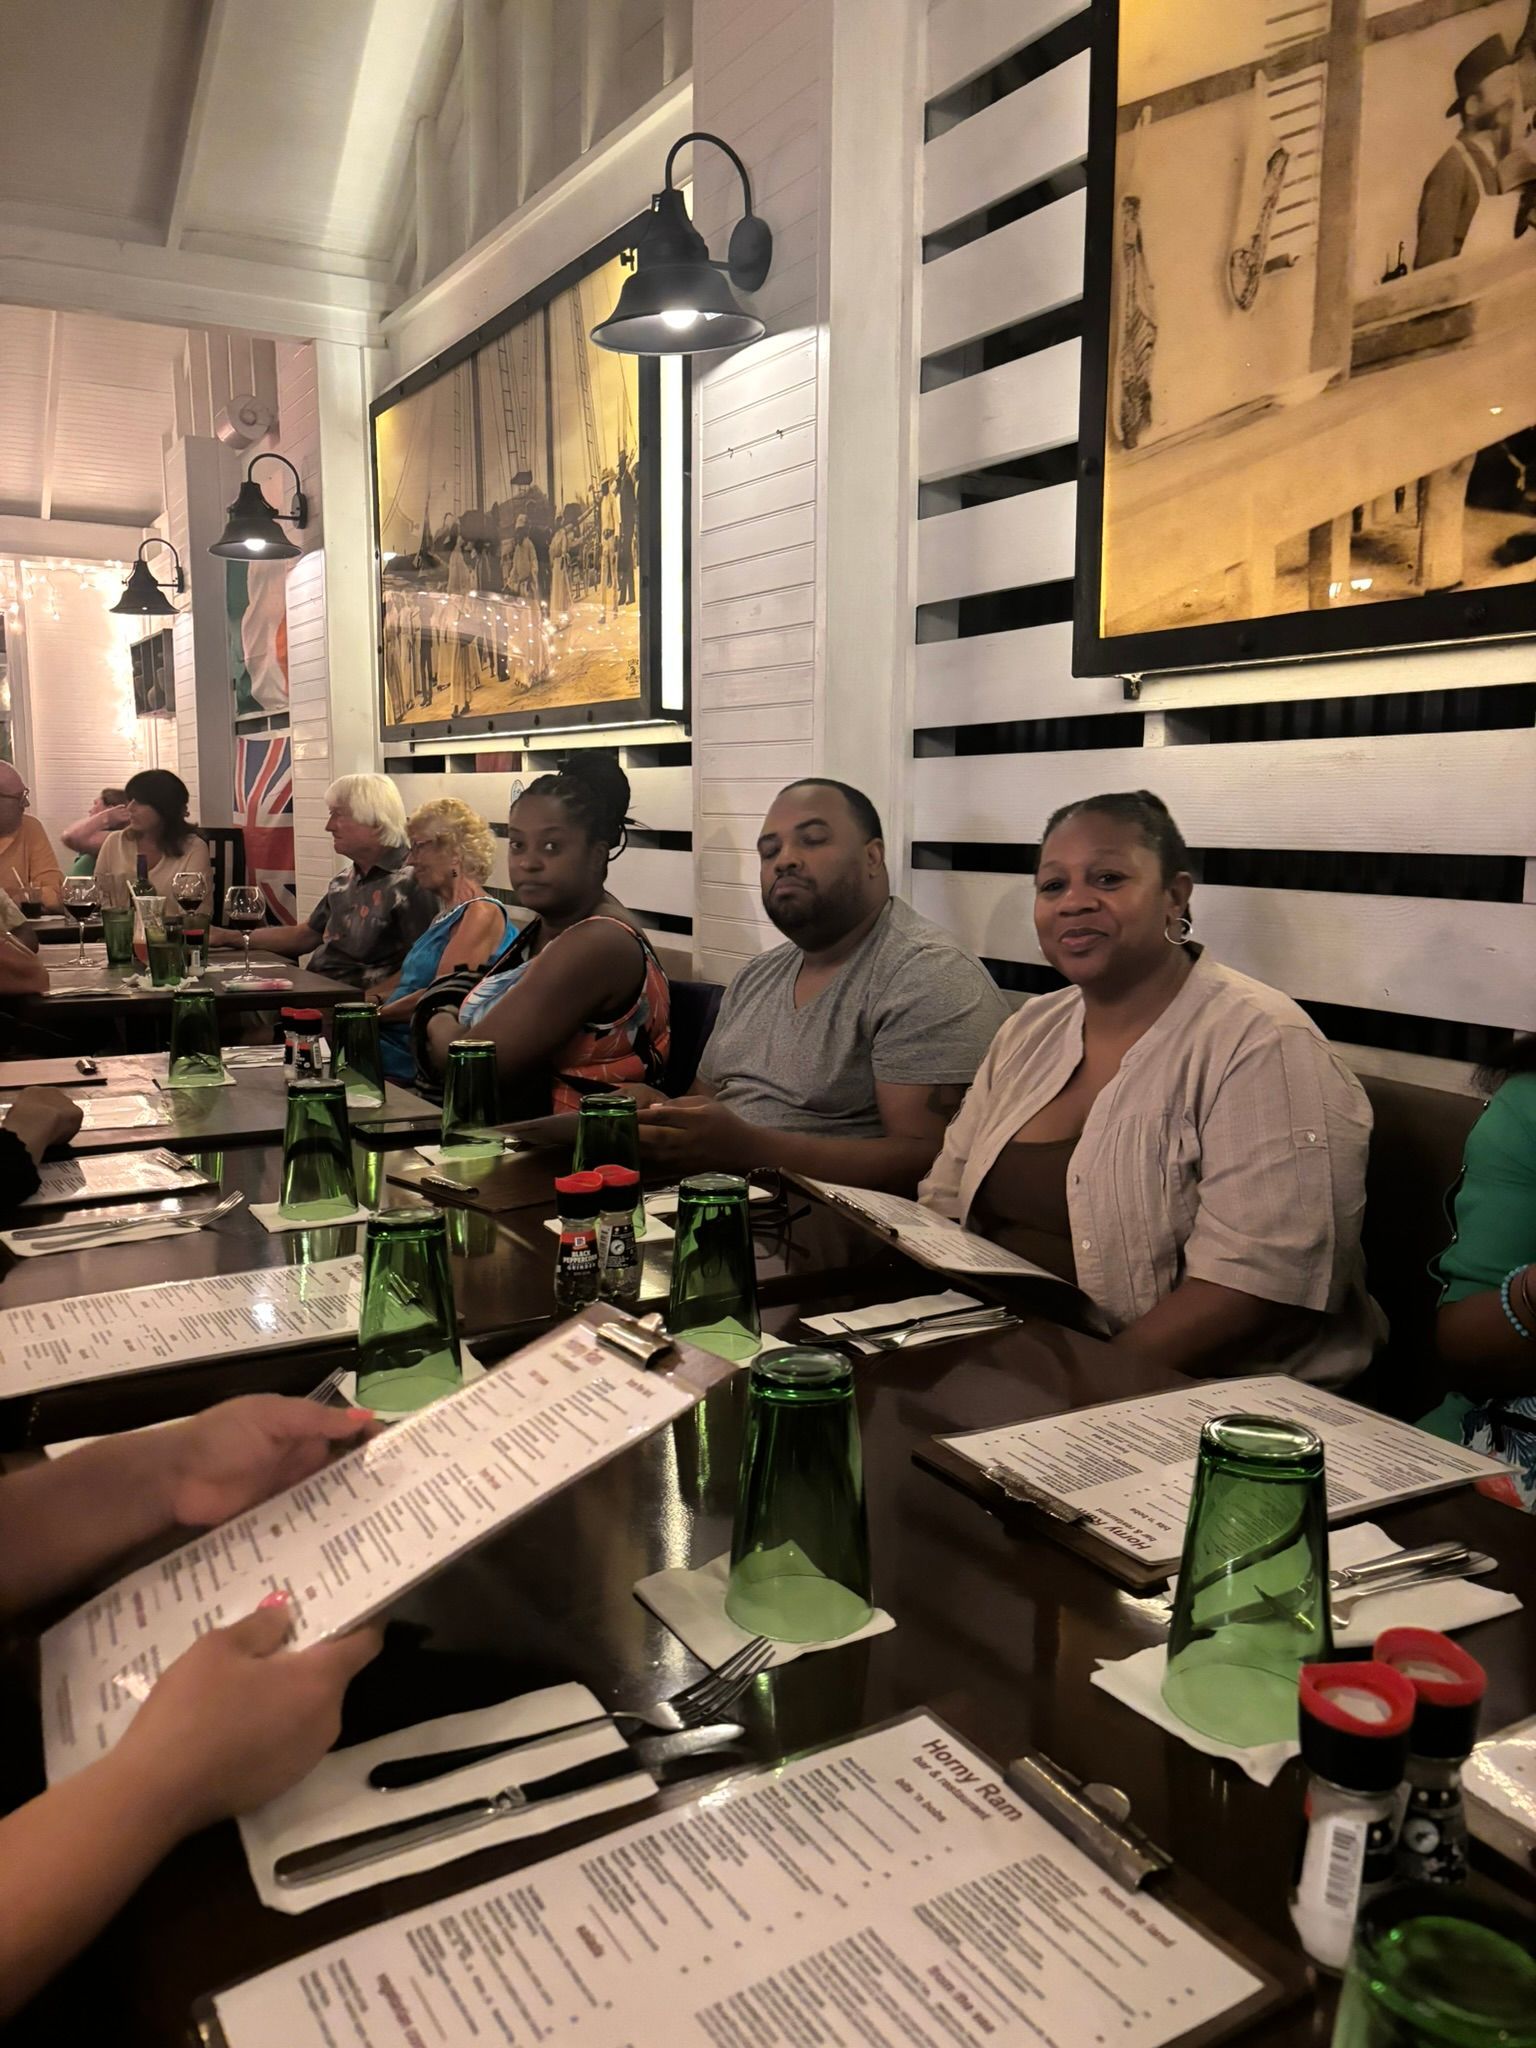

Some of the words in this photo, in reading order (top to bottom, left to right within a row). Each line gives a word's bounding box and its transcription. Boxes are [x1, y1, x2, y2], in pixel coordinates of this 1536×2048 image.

[1095, 1507, 1136, 1530] restaurant
[1104, 1526, 1152, 1550] Horny
[1141, 1533, 1157, 1542] bar
[912, 1755, 932, 1770] bar
[928, 1770, 942, 1778] &
[936, 1777, 991, 1821] restaurant
[922, 1738, 982, 1784] Horny
[974, 1782, 1023, 1821] Ram
[895, 1778, 914, 1793] bits
[922, 1801, 947, 1823] bobs
[1098, 1885, 1127, 1912] from
[1124, 1907, 1146, 1927] the
[1145, 1923, 1177, 1949] land
[953, 1991, 974, 2012] the
